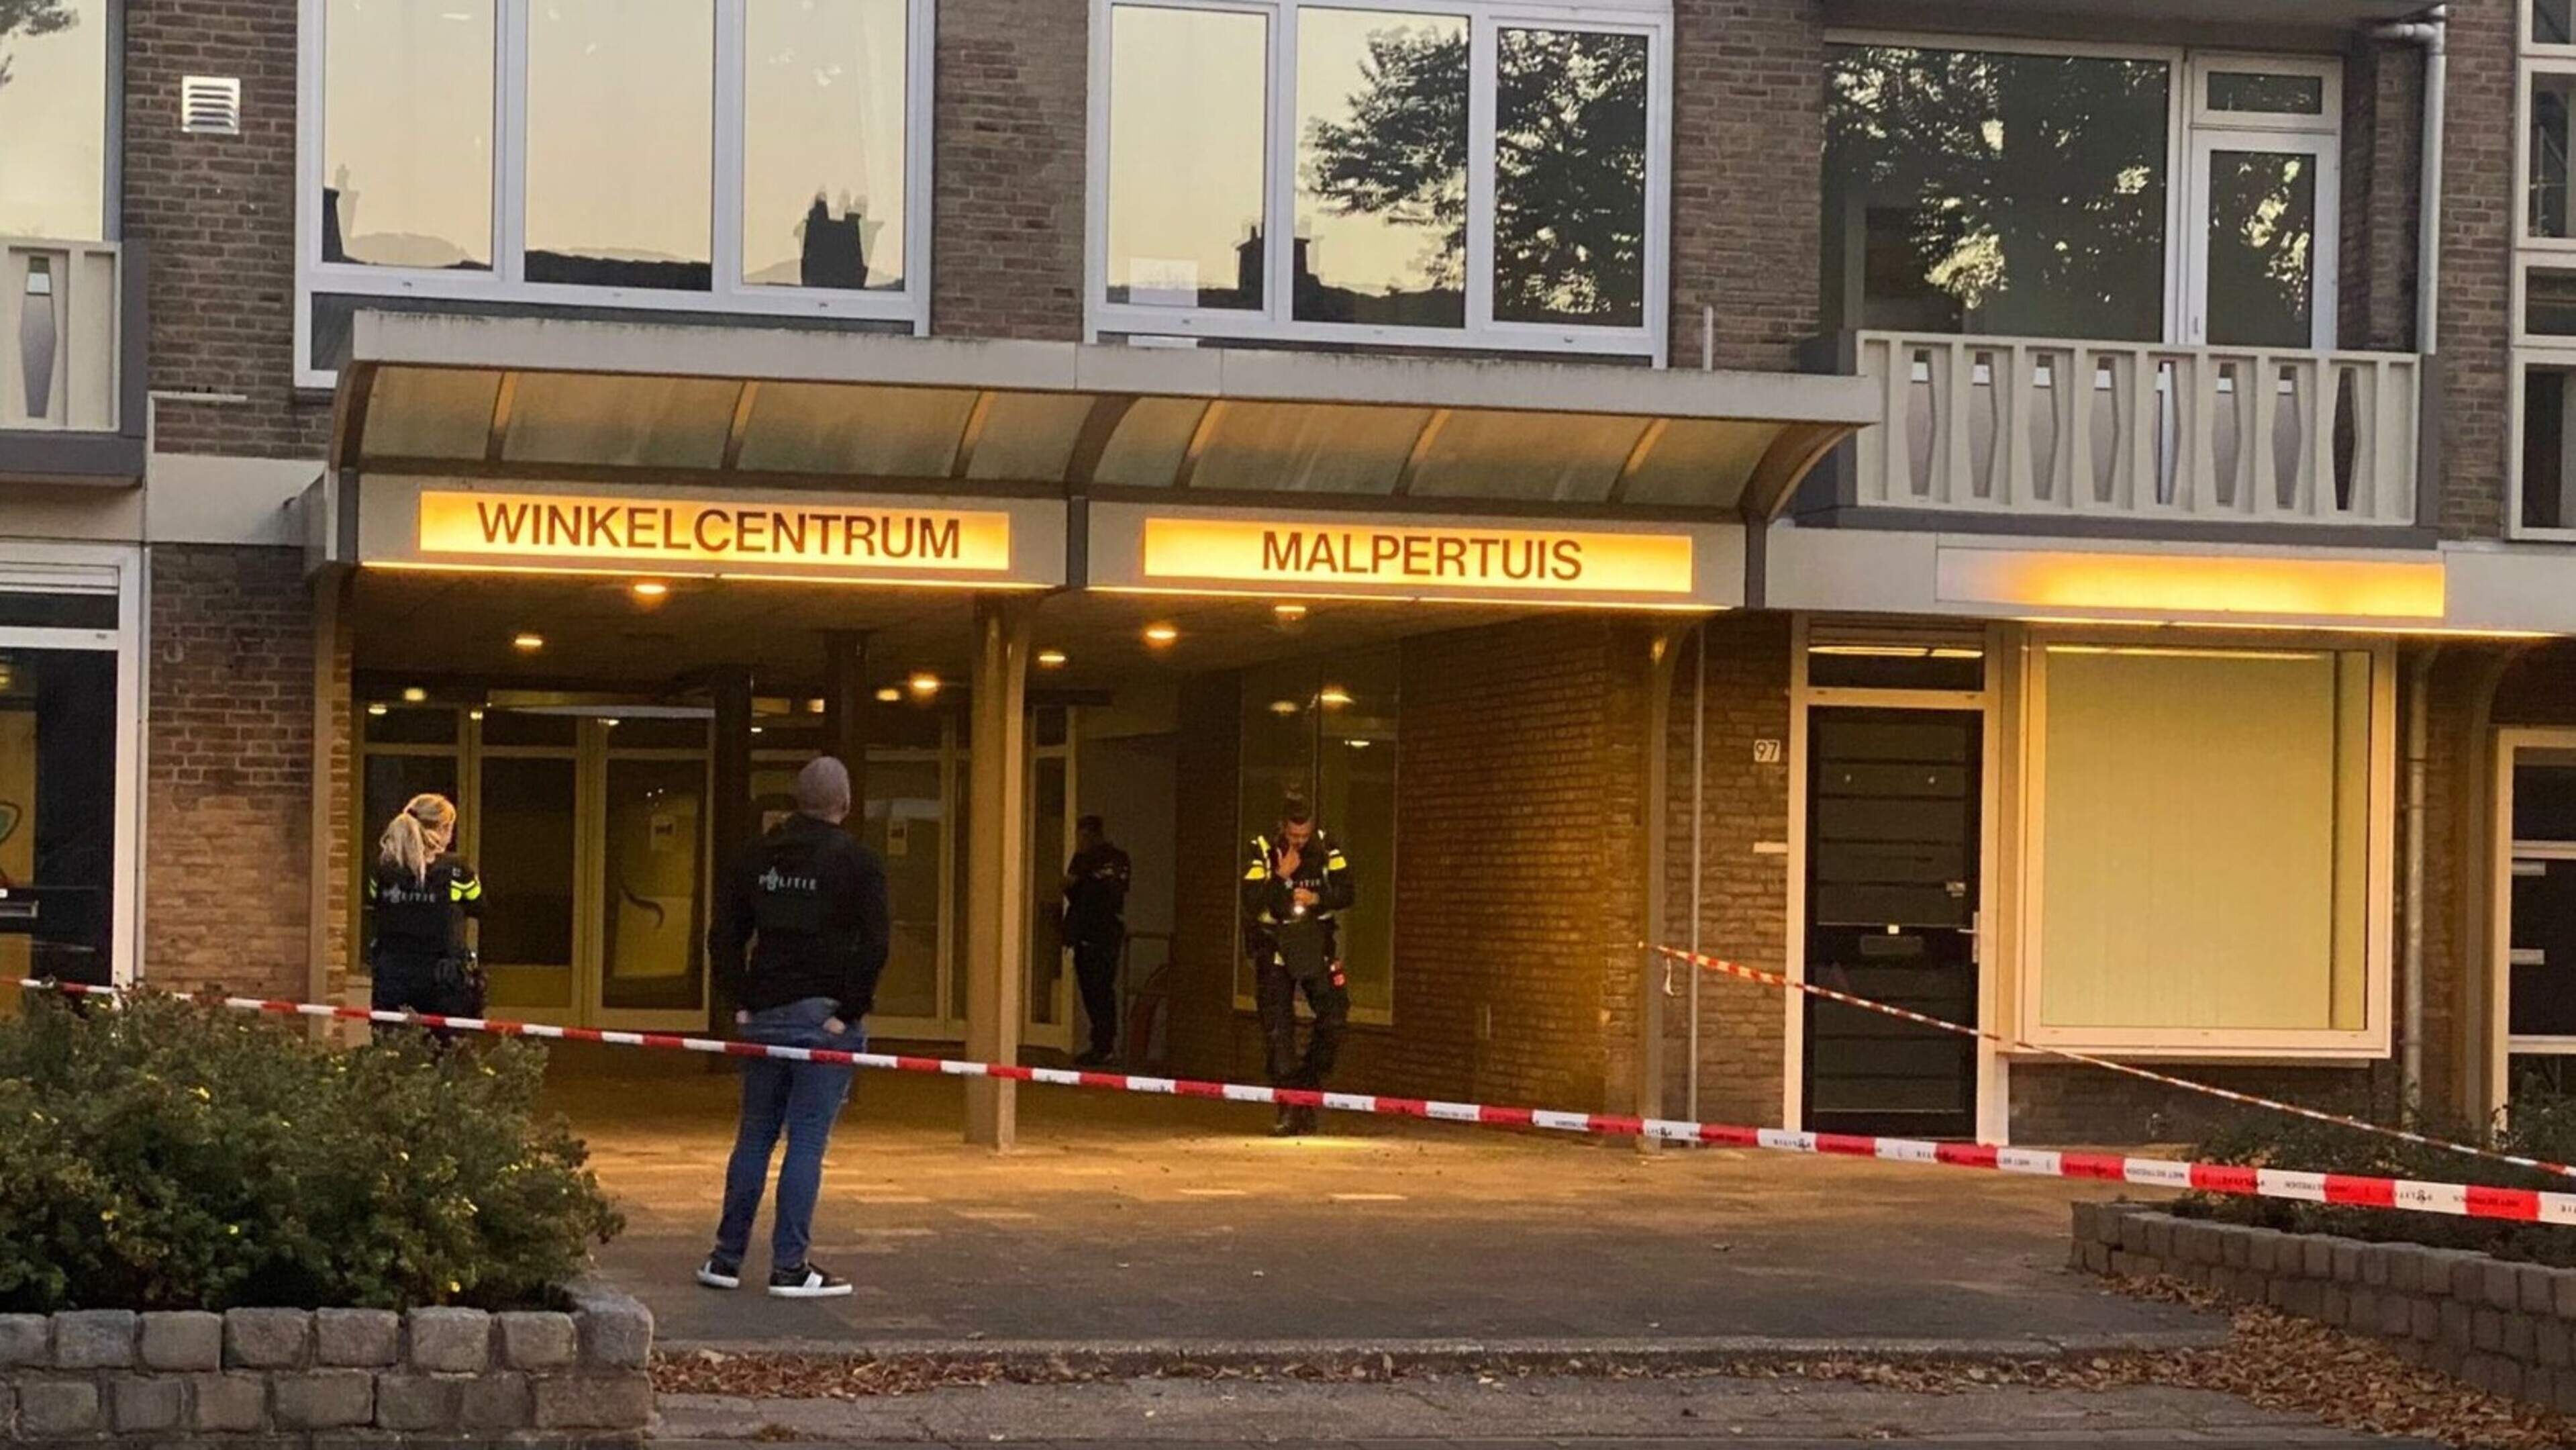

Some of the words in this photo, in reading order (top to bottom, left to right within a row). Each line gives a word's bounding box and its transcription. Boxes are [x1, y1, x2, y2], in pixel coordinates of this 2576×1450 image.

[477, 502, 960, 560] WINKELCENTRUM
[1262, 530, 1583, 581] MALPERTUIS
[1756, 741, 1778, 760] 97
[758, 865, 817, 891] POLITIE
